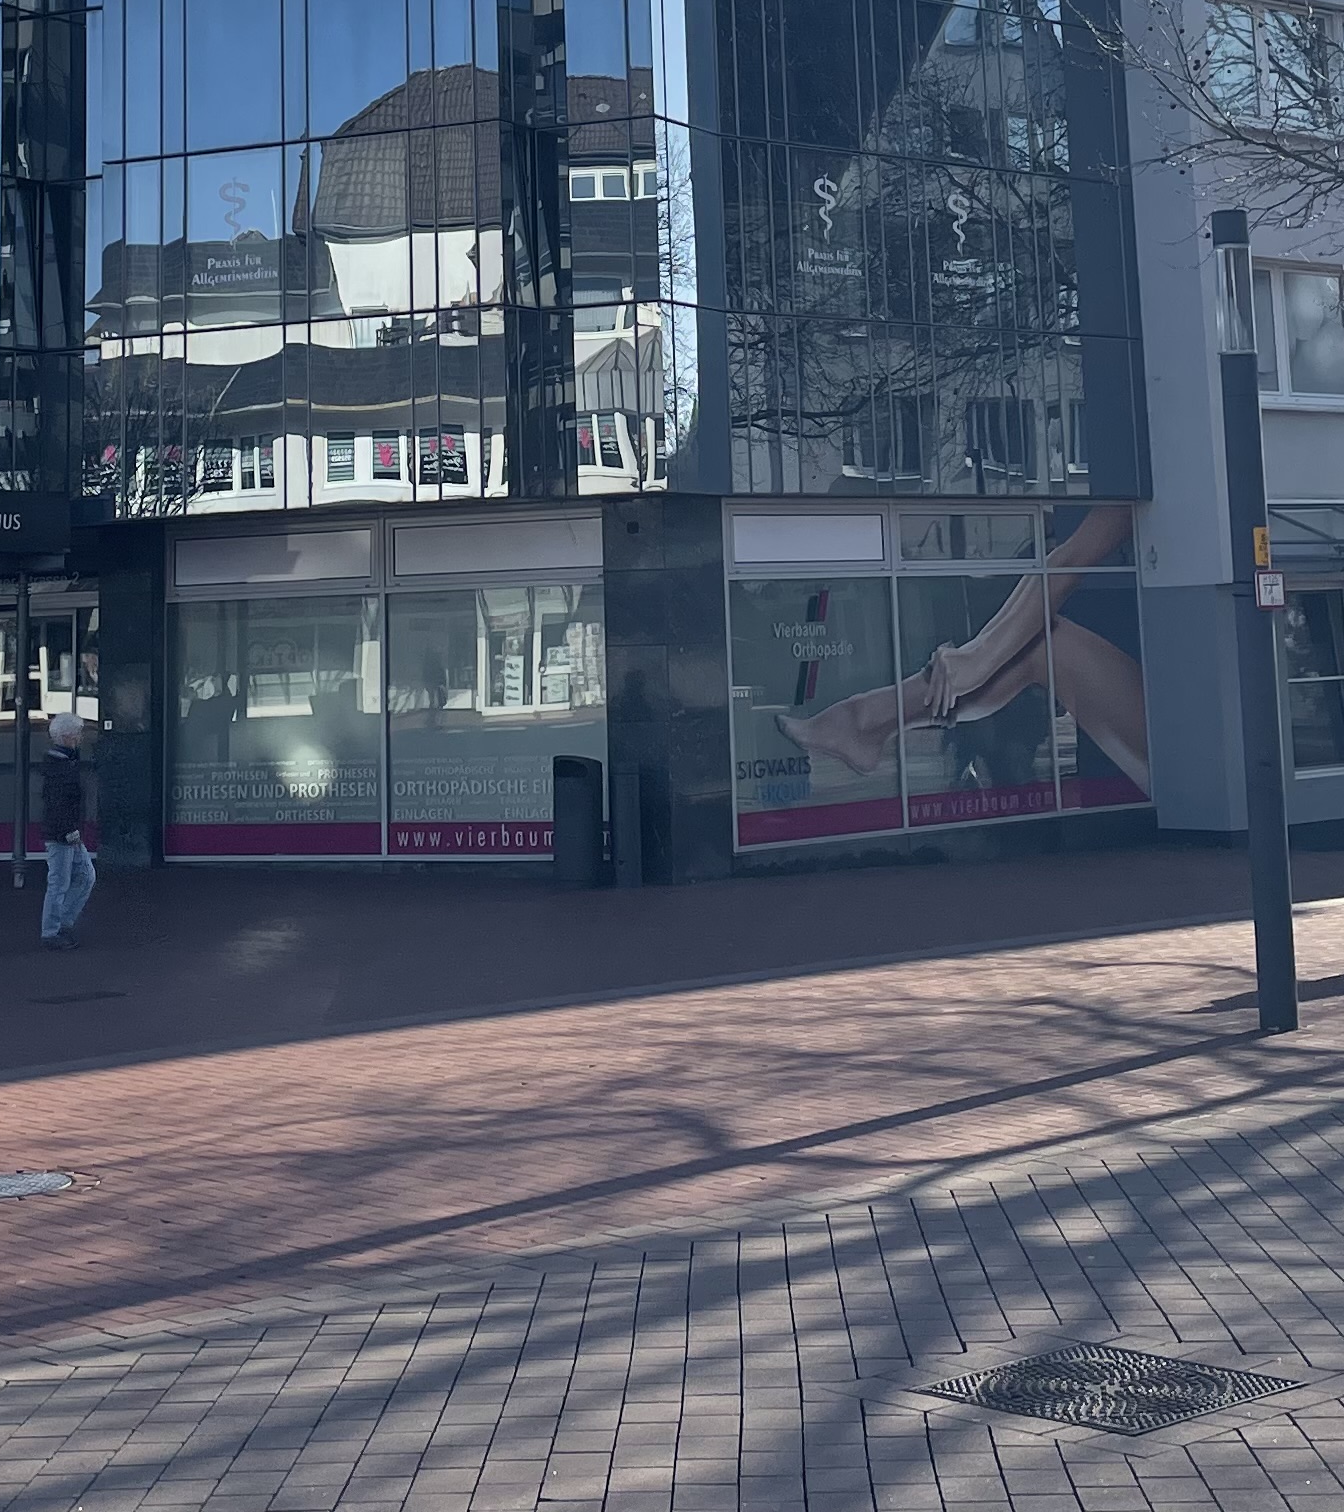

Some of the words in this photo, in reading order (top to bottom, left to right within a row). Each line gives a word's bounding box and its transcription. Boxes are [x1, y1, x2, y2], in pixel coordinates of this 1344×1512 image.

[773, 622, 827, 639] Vierbaum
[792, 640, 855, 660] Orthopädie
[211, 770, 269, 781] PROTHESEN
[317, 768, 376, 780] PROTHESEN
[736, 756, 812, 780] SIGVARIS
[172, 784, 248, 801] ORTHESEN
[252, 783, 286, 799] UND
[289, 782, 377, 798] PROTHESEN
[393, 776, 528, 796] ORTHOPÄDISCHE
[394, 808, 453, 820] EINLAGEN
[910, 791, 1054, 819] www.vierbaum.com
[172, 810, 229, 822] ORTHESEN
[275, 809, 335, 821] ORTHESEN
